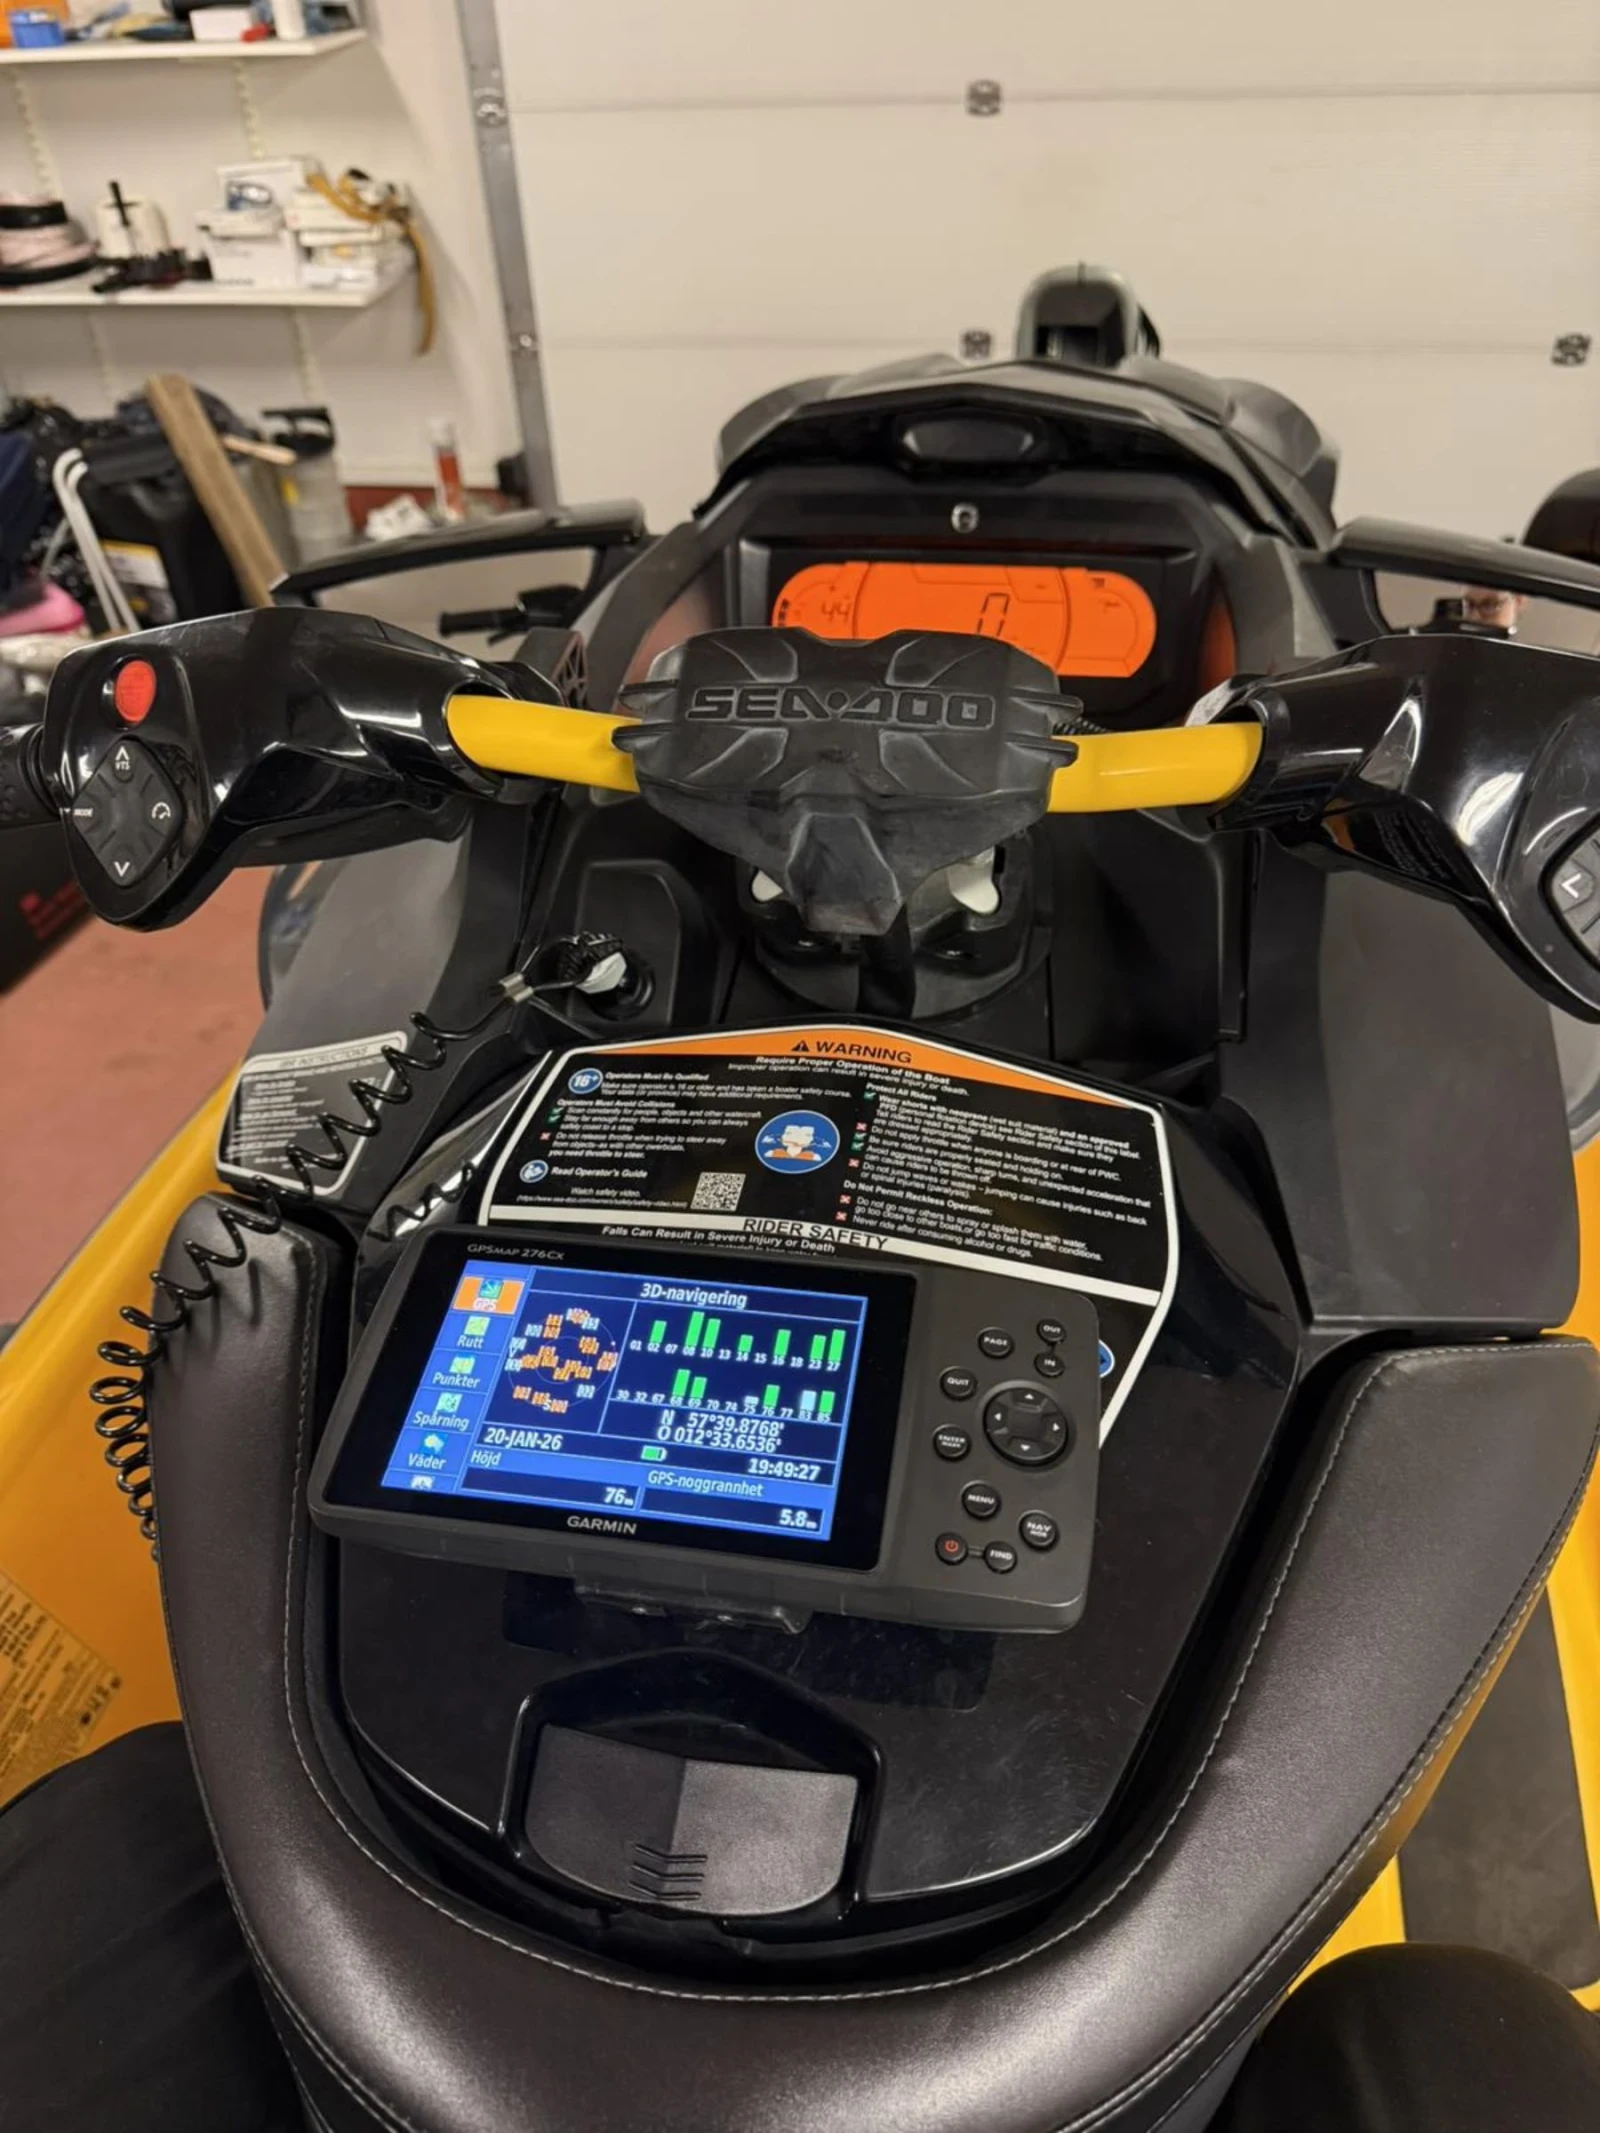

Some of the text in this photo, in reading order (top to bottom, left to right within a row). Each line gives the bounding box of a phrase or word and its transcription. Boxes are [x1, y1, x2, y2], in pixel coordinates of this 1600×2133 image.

[115, 760, 130, 771] VTS
[815, 1041, 912, 1063] WARNING
[755, 1056, 949, 1084] Require Proper Operation of the Boat
[866, 1083, 937, 1101] Protect All Riders
[871, 1126, 883, 1134] Do
[884, 1128, 897, 1137] not
[1013, 1154, 1048, 1168] boarding
[550, 1167, 573, 1175] Read
[620, 1170, 648, 1178] Guide
[842, 1181, 992, 1217] Do Not Permit Reckless Operation:
[861, 1163, 874, 1171] Do
[875, 1165, 889, 1173] not
[890, 1168, 911, 1179] jump
[912, 1173, 938, 1182] waves
[1018, 1194, 1034, 1202] can
[1036, 1197, 1060, 1207] cause
[1062, 1202, 1092, 1216] injuries
[1093, 1208, 1113, 1218] such
[1127, 1215, 1146, 1225] back
[856, 1198, 869, 1206] Do
[870, 1201, 883, 1209] not
[885, 1204, 896, 1212] go
[918, 1209, 945, 1220] others
[956, 1217, 978, 1228] spray
[992, 1223, 1019, 1236] splash
[1021, 1229, 1041, 1239] them
[1044, 1233, 1060, 1243] with
[601, 1227, 628, 1236] Falls
[629, 1229, 652, 1237] Can
[654, 1230, 691, 1239] Result
[692, 1232, 705, 1240] in
[706, 1232, 746, 1242] Severe
[748, 1235, 782, 1247] Injury
[800, 1240, 835, 1253] Death
[743, 1218, 804, 1235] RIDER
[809, 1224, 888, 1250] SAFETY
[852, 1216, 877, 1226] Never
[879, 1220, 895, 1229] ride
[896, 1223, 915, 1233] after
[917, 1227, 962, 1244] consuming
[964, 1237, 994, 1249] alcohol
[473, 1298, 497, 1311] GPS
[640, 1282, 747, 1309] 3D-navigering
[1043, 1324, 1061, 1334] OUT
[457, 1335, 484, 1349] Rutt
[984, 1336, 1008, 1347] PAGE
[630, 1340, 641, 1350] 01
[665, 1344, 677, 1354] 07
[701, 1348, 713, 1358] 10
[719, 1350, 731, 1360] 13
[736, 1351, 748, 1361] 14
[755, 1353, 766, 1363] 15
[809, 1359, 821, 1369] 23
[827, 1361, 839, 1371] 27
[1044, 1359, 1056, 1367] IN
[432, 1373, 481, 1388] Punkter
[947, 1376, 970, 1387] QUIT
[635, 1392, 647, 1402] 32
[670, 1396, 683, 1406] 68
[688, 1398, 701, 1408] 69
[707, 1400, 719, 1410] 70
[725, 1402, 737, 1412] 74
[744, 1404, 756, 1414] 75
[762, 1406, 774, 1415] 76
[780, 1408, 793, 1418] 77
[413, 1411, 470, 1431] Spårning
[661, 1410, 674, 1425] N
[483, 1427, 564, 1450] 20-JAN-26
[938, 1434, 966, 1444] ENTER
[408, 1453, 446, 1470] Väder
[470, 1450, 502, 1466] Höjd
[747, 1457, 821, 1481] 19:49:27
[647, 1469, 763, 1497] GPS-noggrannhet
[968, 1494, 995, 1505] MENU
[566, 1516, 637, 1534] GARMIN
[1026, 1520, 1053, 1532] NAV
[990, 1550, 1013, 1560] FIND
